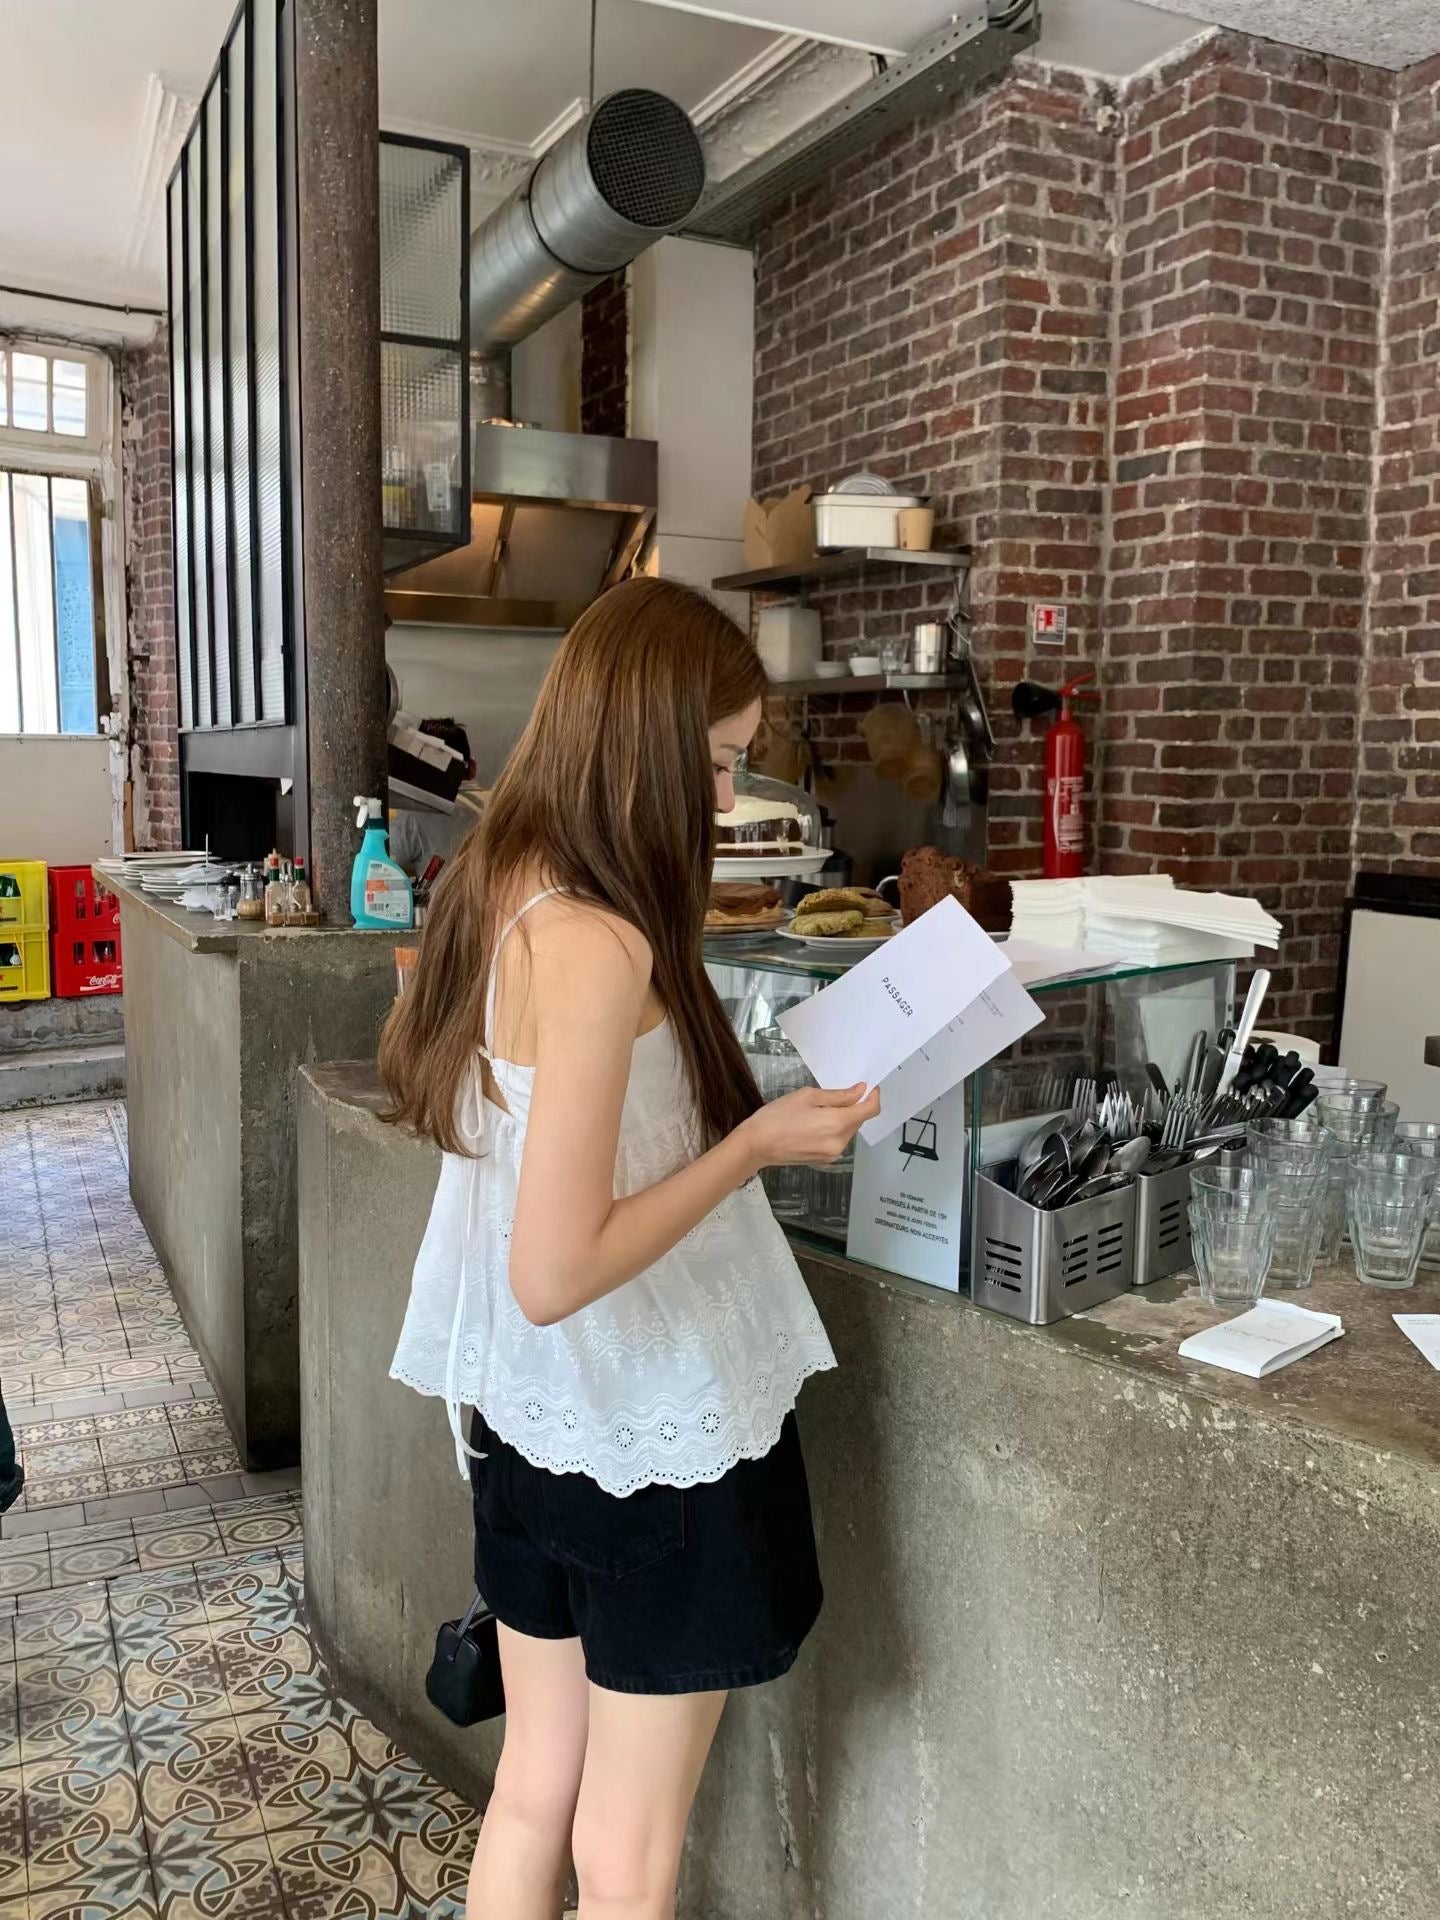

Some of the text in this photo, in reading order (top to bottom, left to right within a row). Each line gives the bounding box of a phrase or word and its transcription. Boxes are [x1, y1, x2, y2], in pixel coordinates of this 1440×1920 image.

[881, 976, 913, 1018] PASSAGER
[930, 1209, 937, 1217] DE
[875, 1218, 909, 1233] ORDINATEURS
[910, 1228, 922, 1236] NON
